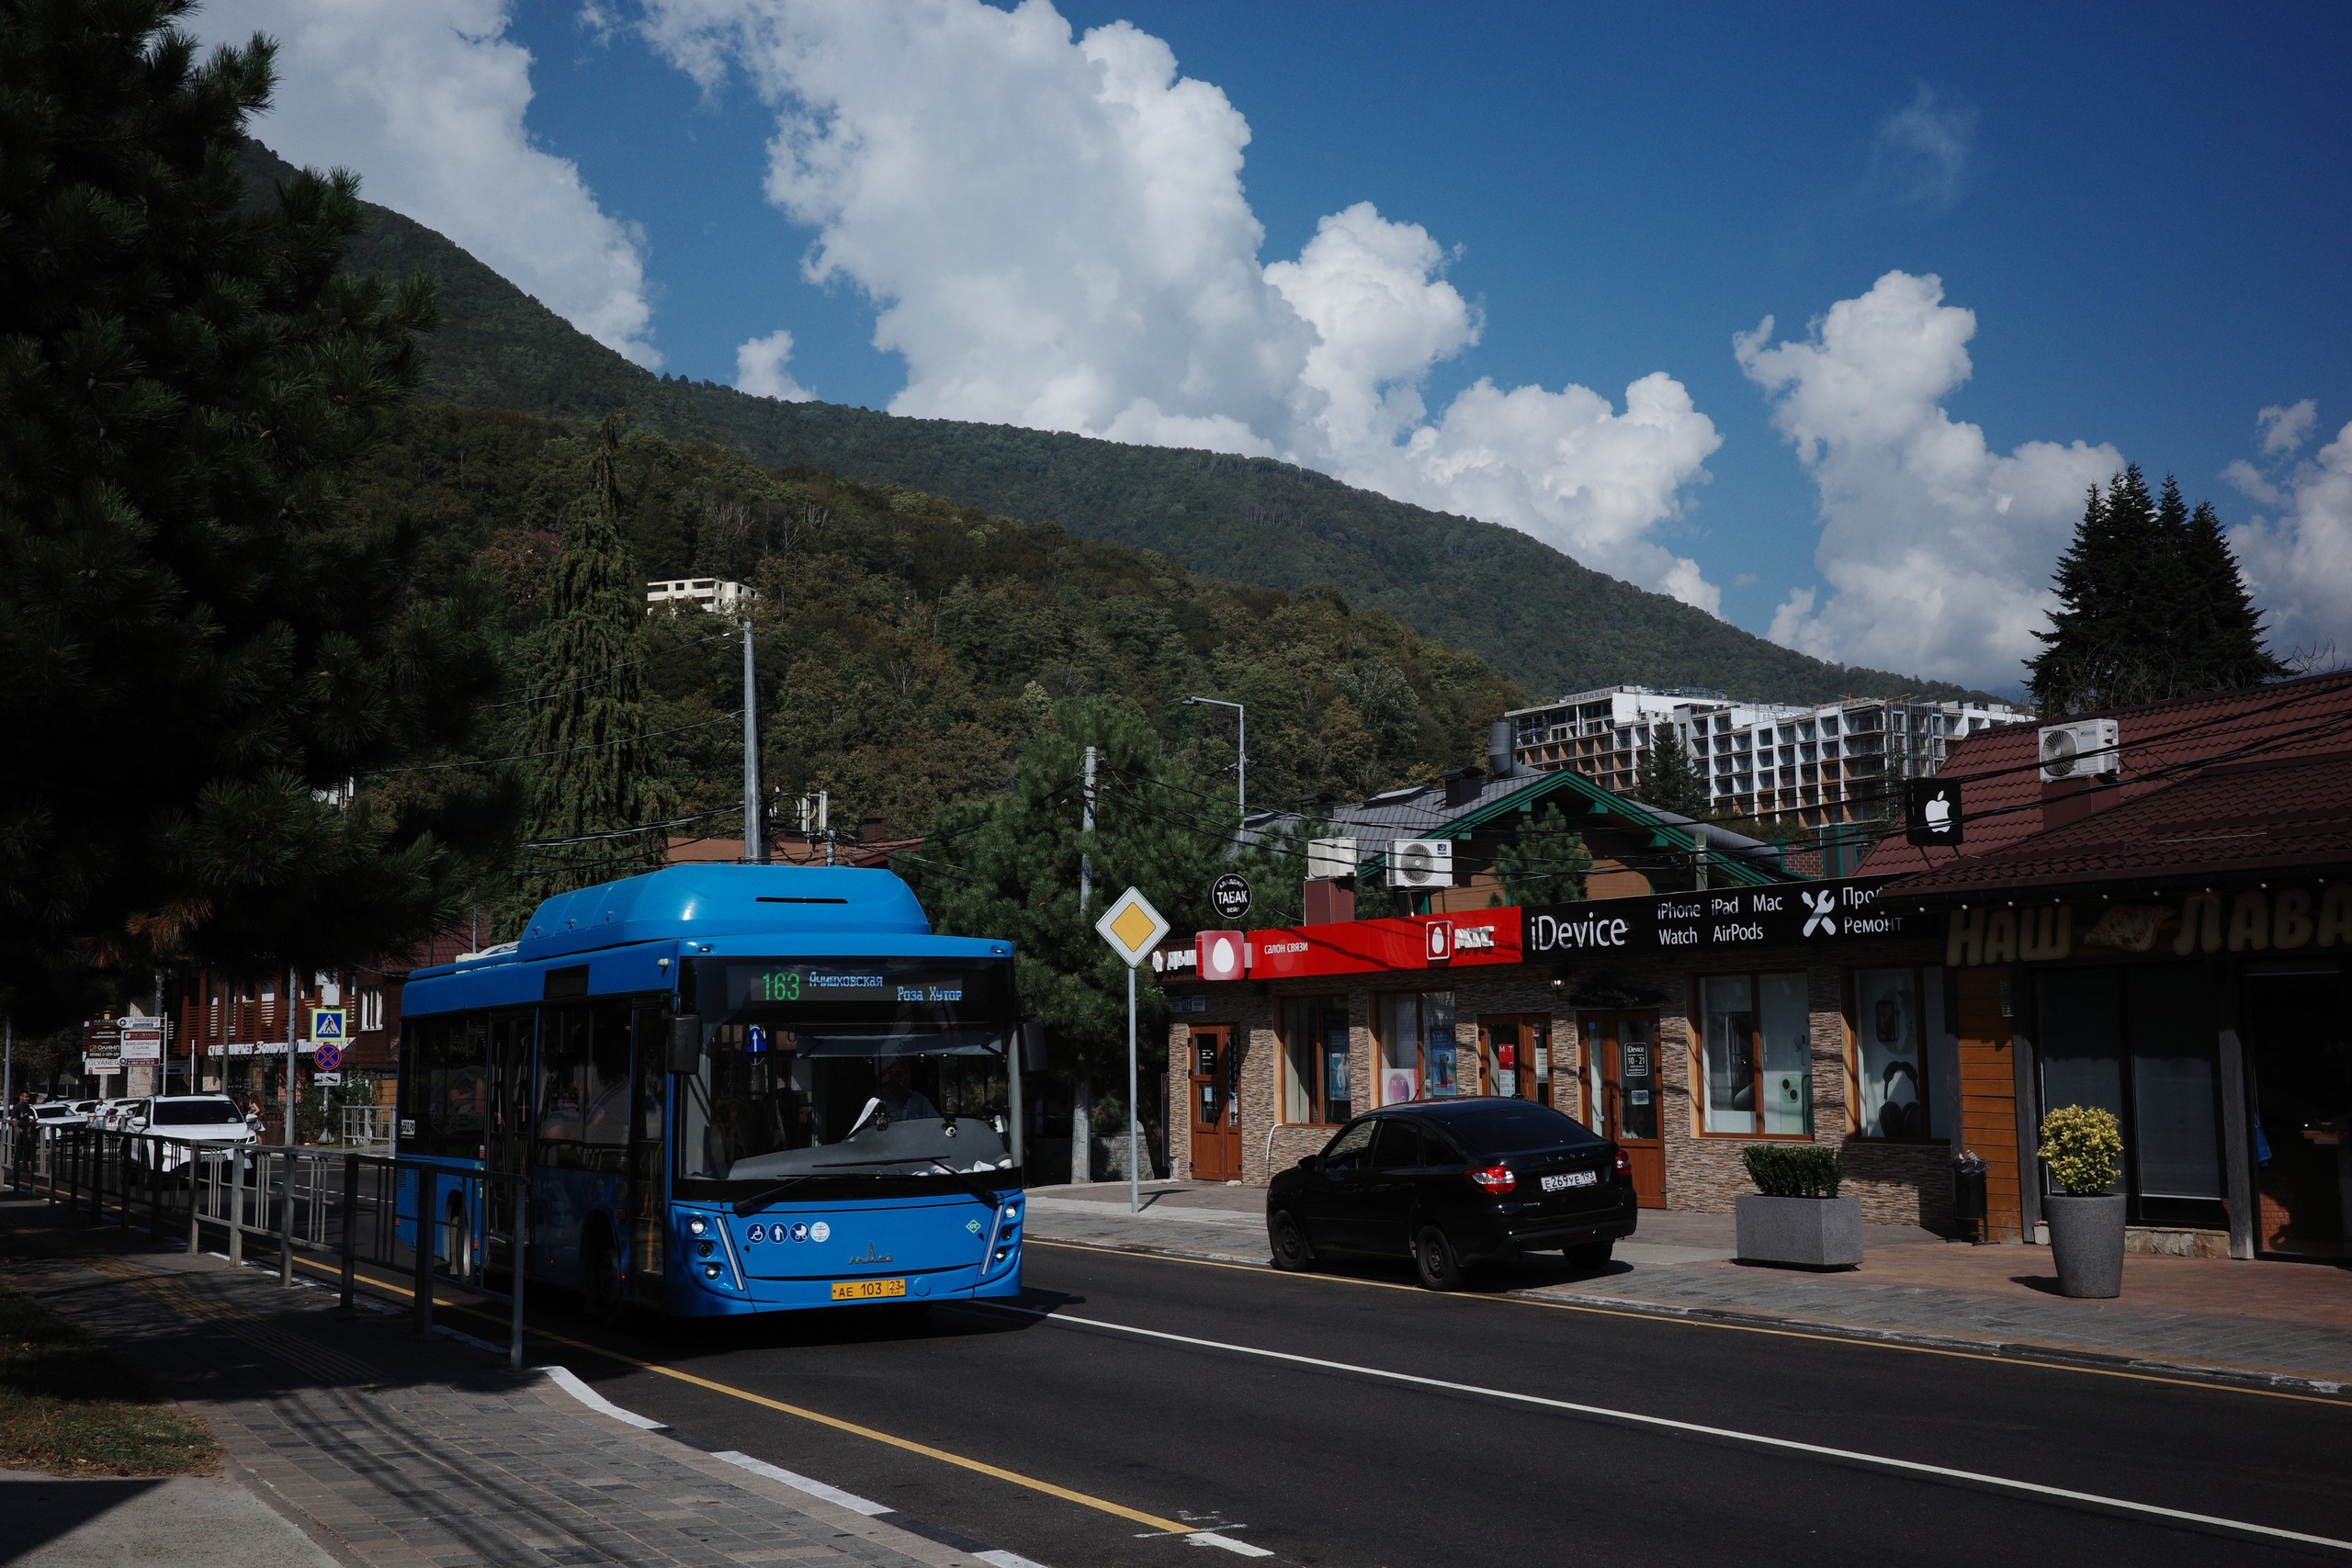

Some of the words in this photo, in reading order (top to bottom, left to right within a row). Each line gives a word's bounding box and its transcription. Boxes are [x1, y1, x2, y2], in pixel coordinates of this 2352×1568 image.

[1216, 890, 1248, 905] ТАБАК
[1657, 902, 1701, 920] iPhone
[1711, 896, 1739, 916] iPad
[1753, 894, 1783, 913] Mac
[1531, 911, 1628, 952] iDevice
[1657, 925, 1699, 945] Watch
[1712, 922, 1764, 942] AirPods
[1844, 916, 1904, 934] Ремонт
[1453, 925, 1496, 950] МТС
[1946, 904, 2074, 966] НАШ
[1263, 942, 1286, 955] салон
[1287, 941, 1308, 953] связи
[762, 972, 800, 1001] 163
[808, 971, 884, 988] Ачишховская
[896, 986, 924, 1002] Роза
[929, 986, 963, 1002] Хутор
[1627, 1045, 1645, 1054] iDevice
[1545, 1151, 1588, 1162] LADA
[859, 1282, 882, 1296] 103
[888, 1280, 901, 1291] 23
